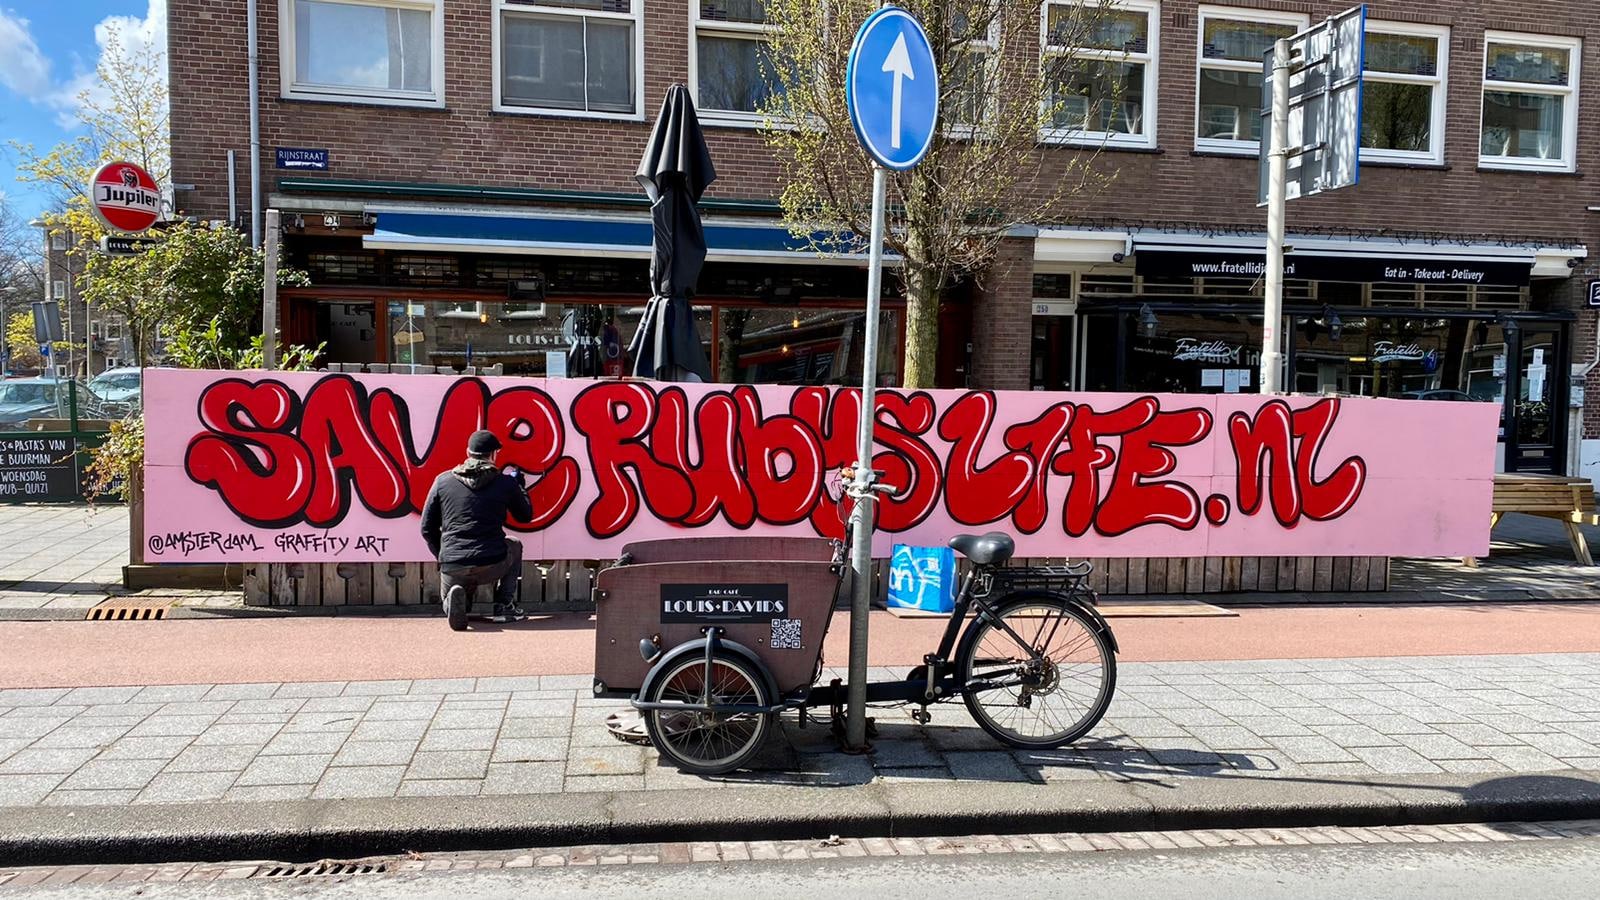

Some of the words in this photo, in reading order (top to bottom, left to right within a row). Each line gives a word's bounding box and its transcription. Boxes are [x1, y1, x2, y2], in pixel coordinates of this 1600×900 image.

[279, 151, 324, 160] RIJNSTRAAT
[100, 186, 158, 207] Jupiler
[1385, 267, 1397, 277] Eat
[1398, 268, 1406, 278] in
[1451, 269, 1484, 282] Delivery
[508, 335, 548, 344] LOUIS
[1175, 337, 1225, 353] Fratelli
[1373, 340, 1418, 356] Fratelli
[48, 440, 66, 450] VAN
[8, 454, 51, 465] BUURMAN
[1, 471, 46, 482] WOENSDAG
[355, 535, 390, 556] ART
[664, 600, 714, 613] LOUIS
[722, 600, 784, 613] DAVIDS
